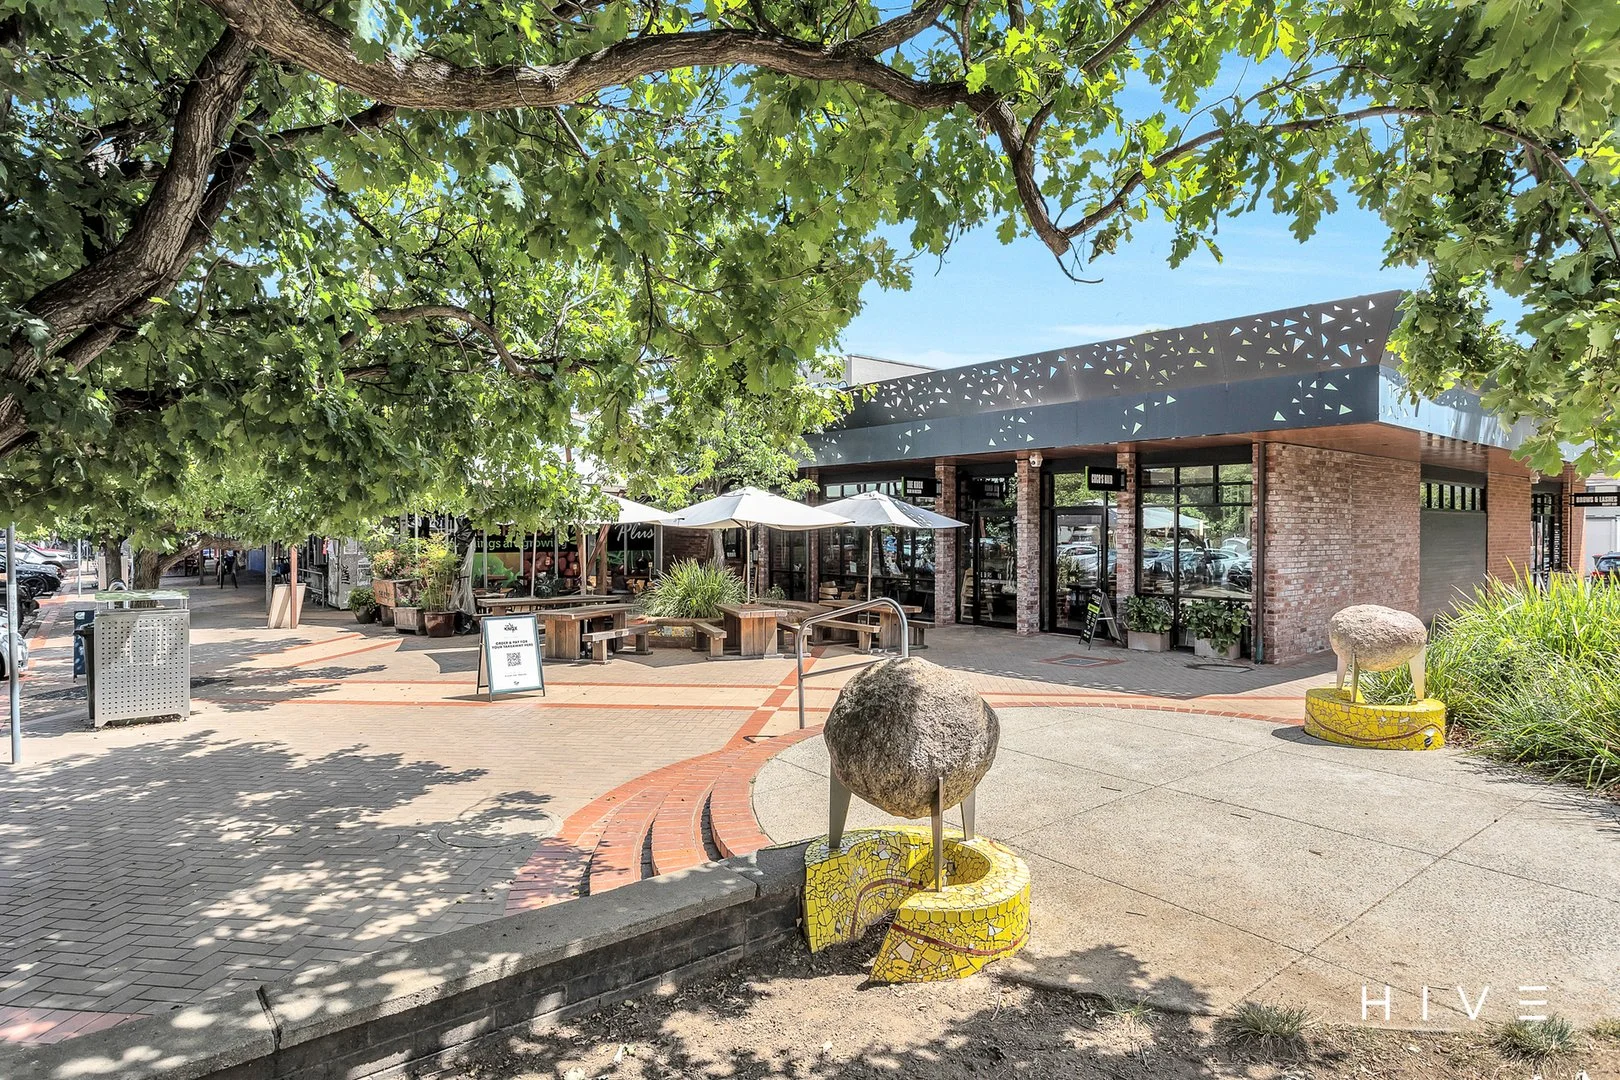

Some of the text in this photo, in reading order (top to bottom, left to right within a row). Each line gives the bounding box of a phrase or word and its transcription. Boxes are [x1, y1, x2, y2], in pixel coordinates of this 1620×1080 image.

[614, 522, 655, 541] Plus
[475, 538, 501, 550] ings
[523, 538, 568, 550] growig
